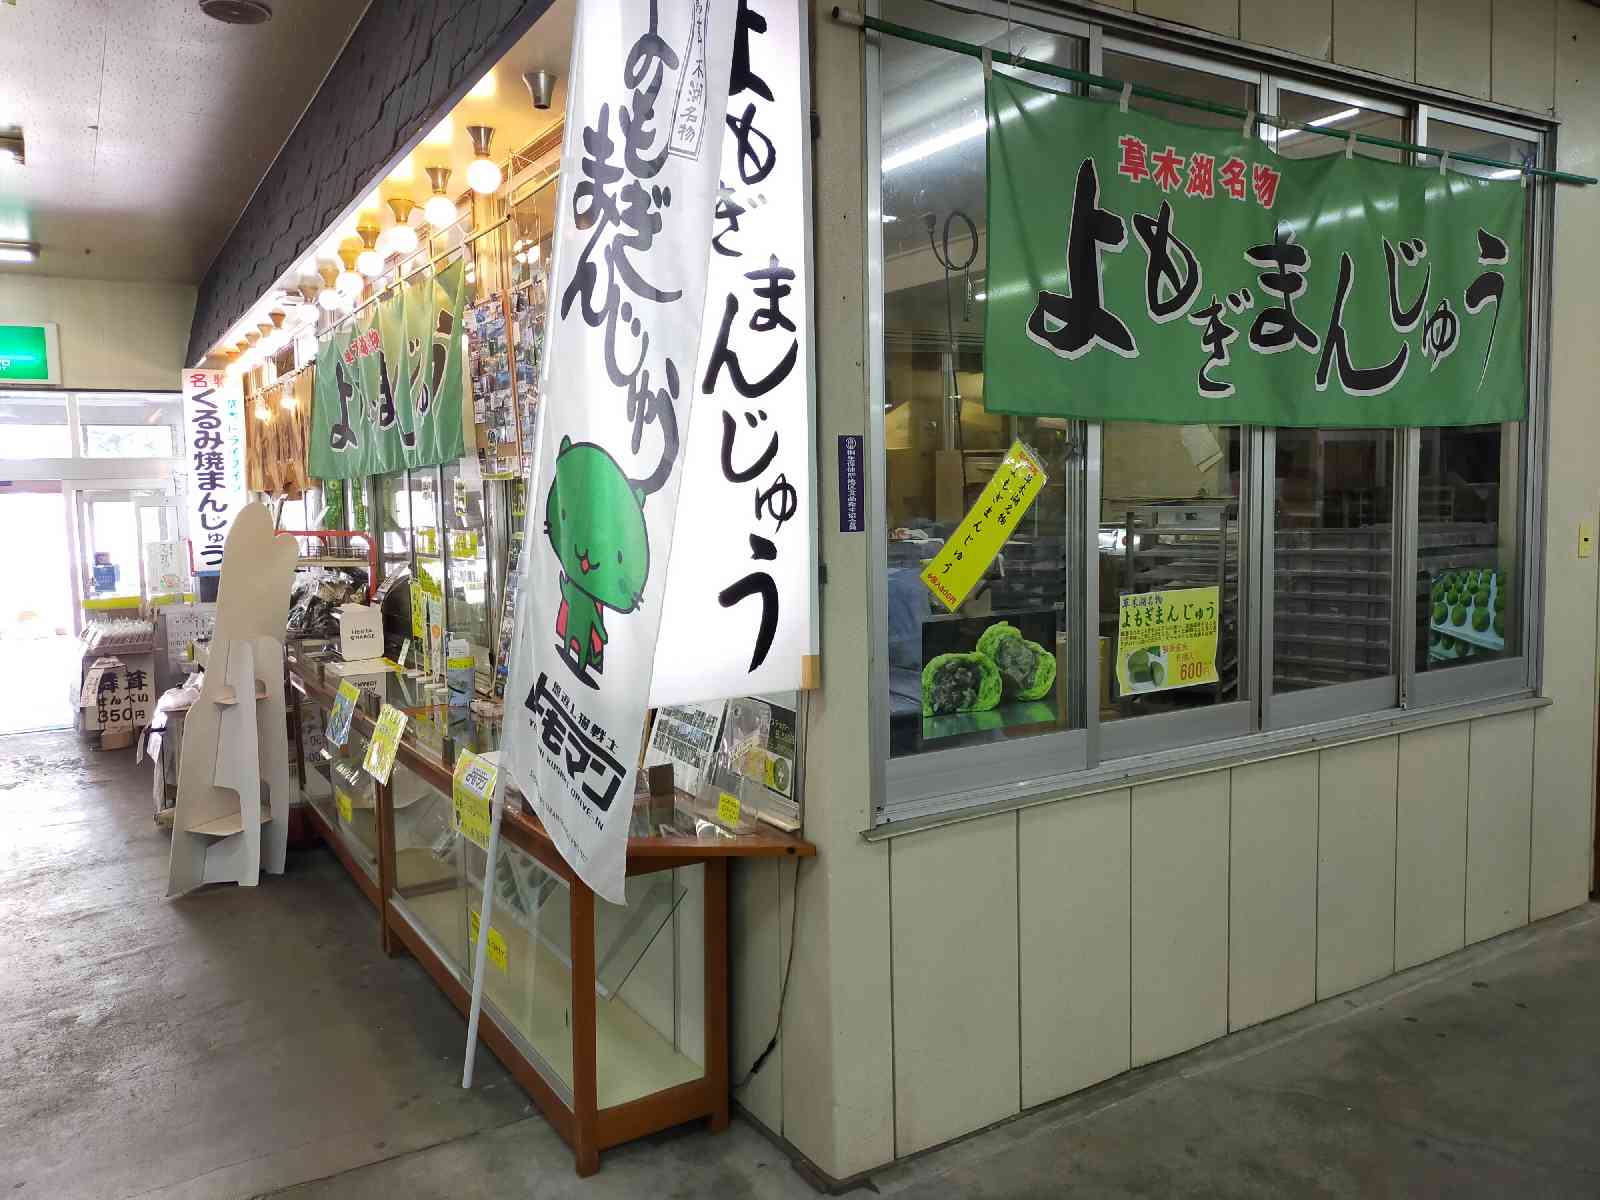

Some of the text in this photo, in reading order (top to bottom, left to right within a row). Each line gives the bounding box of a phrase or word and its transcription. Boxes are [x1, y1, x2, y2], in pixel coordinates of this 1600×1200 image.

[1117, 133, 1281, 209] 草木湖名物
[192, 388, 228, 566] くるみ焼まんじゅう
[1121, 601, 1216, 627] よもぎまんじゅう
[97, 708, 145, 723] 350円
